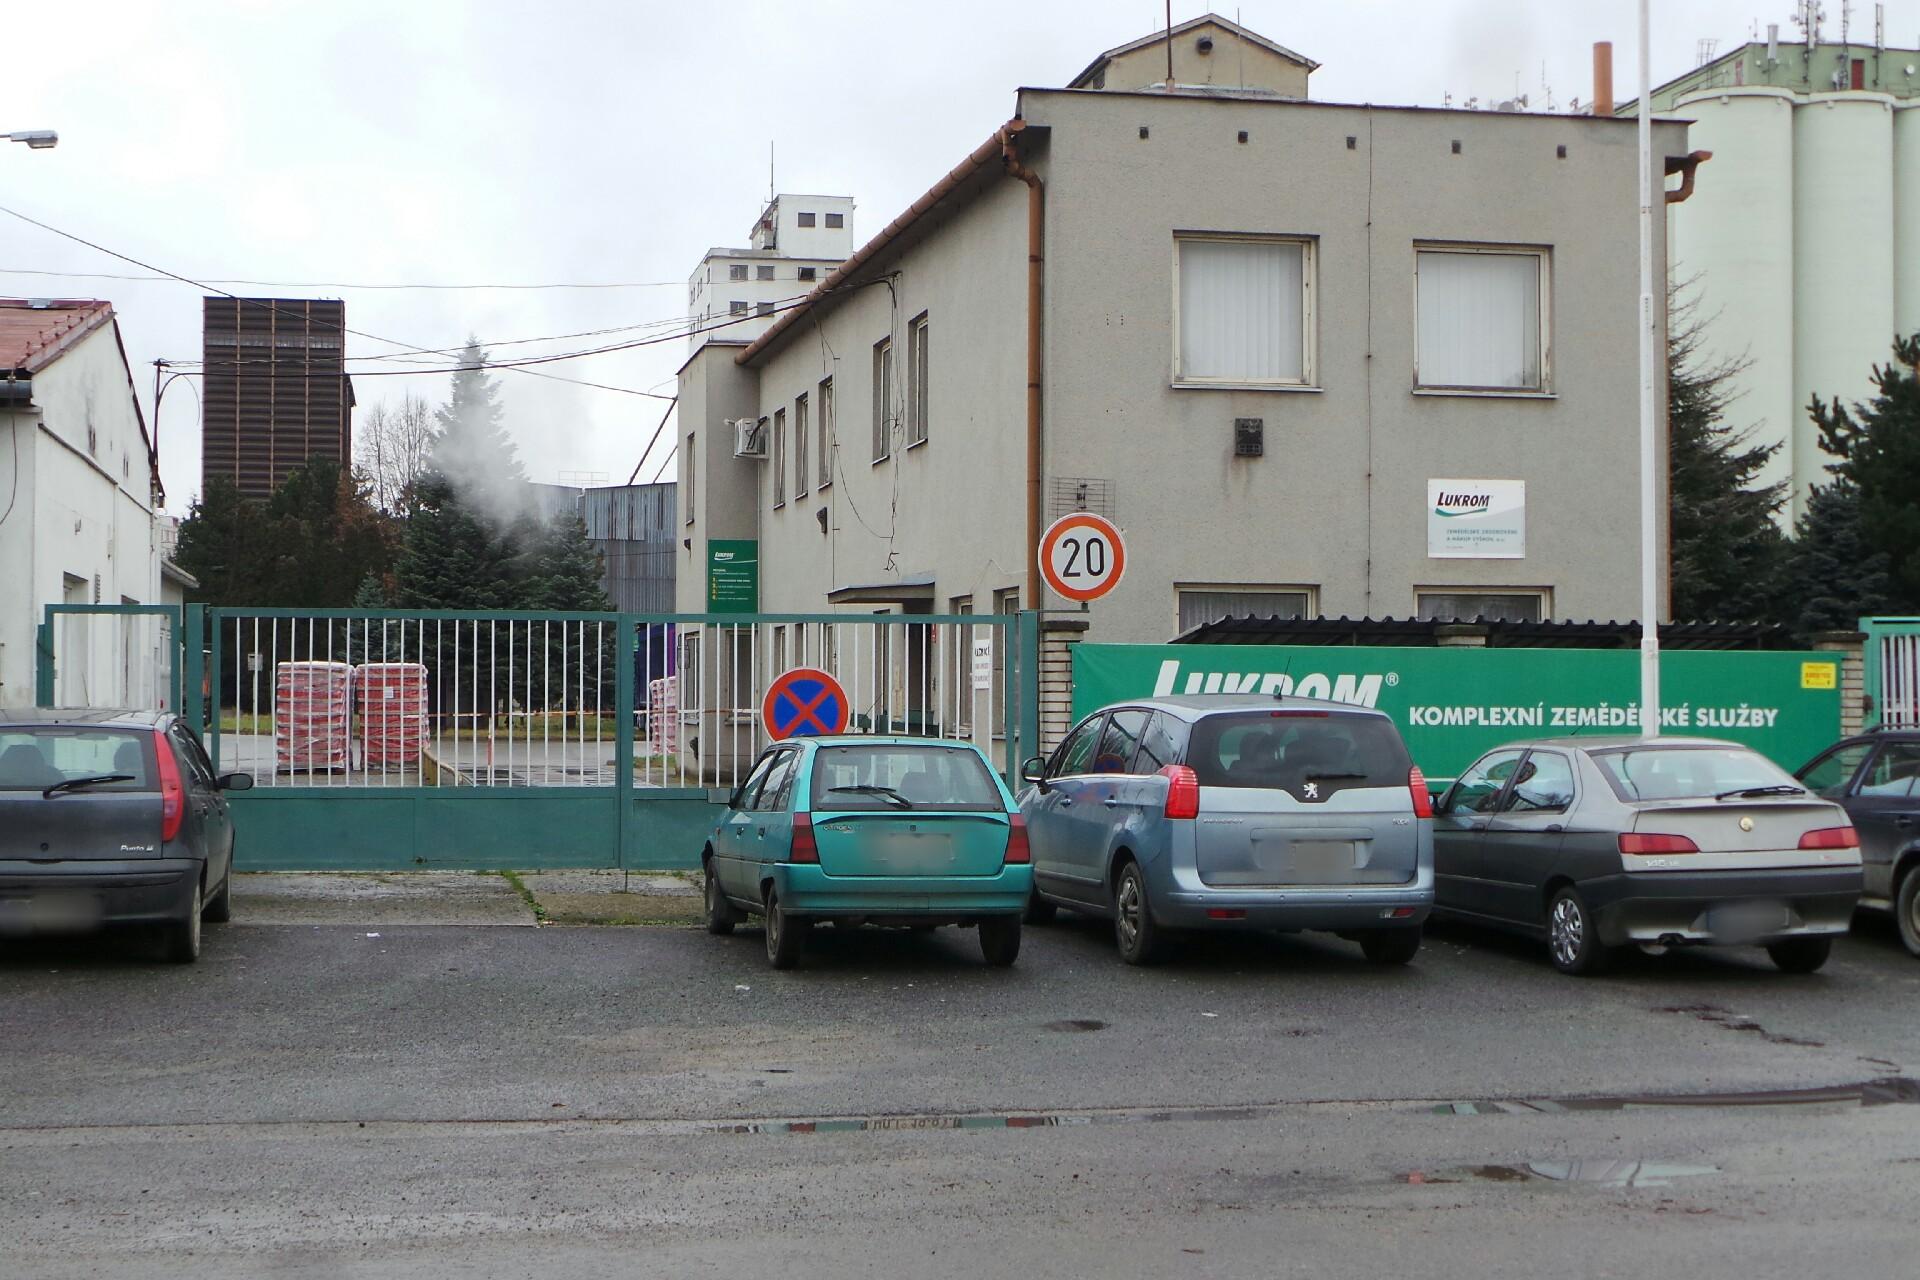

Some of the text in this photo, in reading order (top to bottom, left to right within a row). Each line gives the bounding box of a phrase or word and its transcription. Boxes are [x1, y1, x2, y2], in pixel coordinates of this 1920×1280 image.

[1437, 492, 1490, 507] LUKROM
[1062, 538, 1105, 577] 20
[1409, 702, 1778, 727] KOMPLEXNÍ ZEMĚDĚKÉ SLUŽBY
